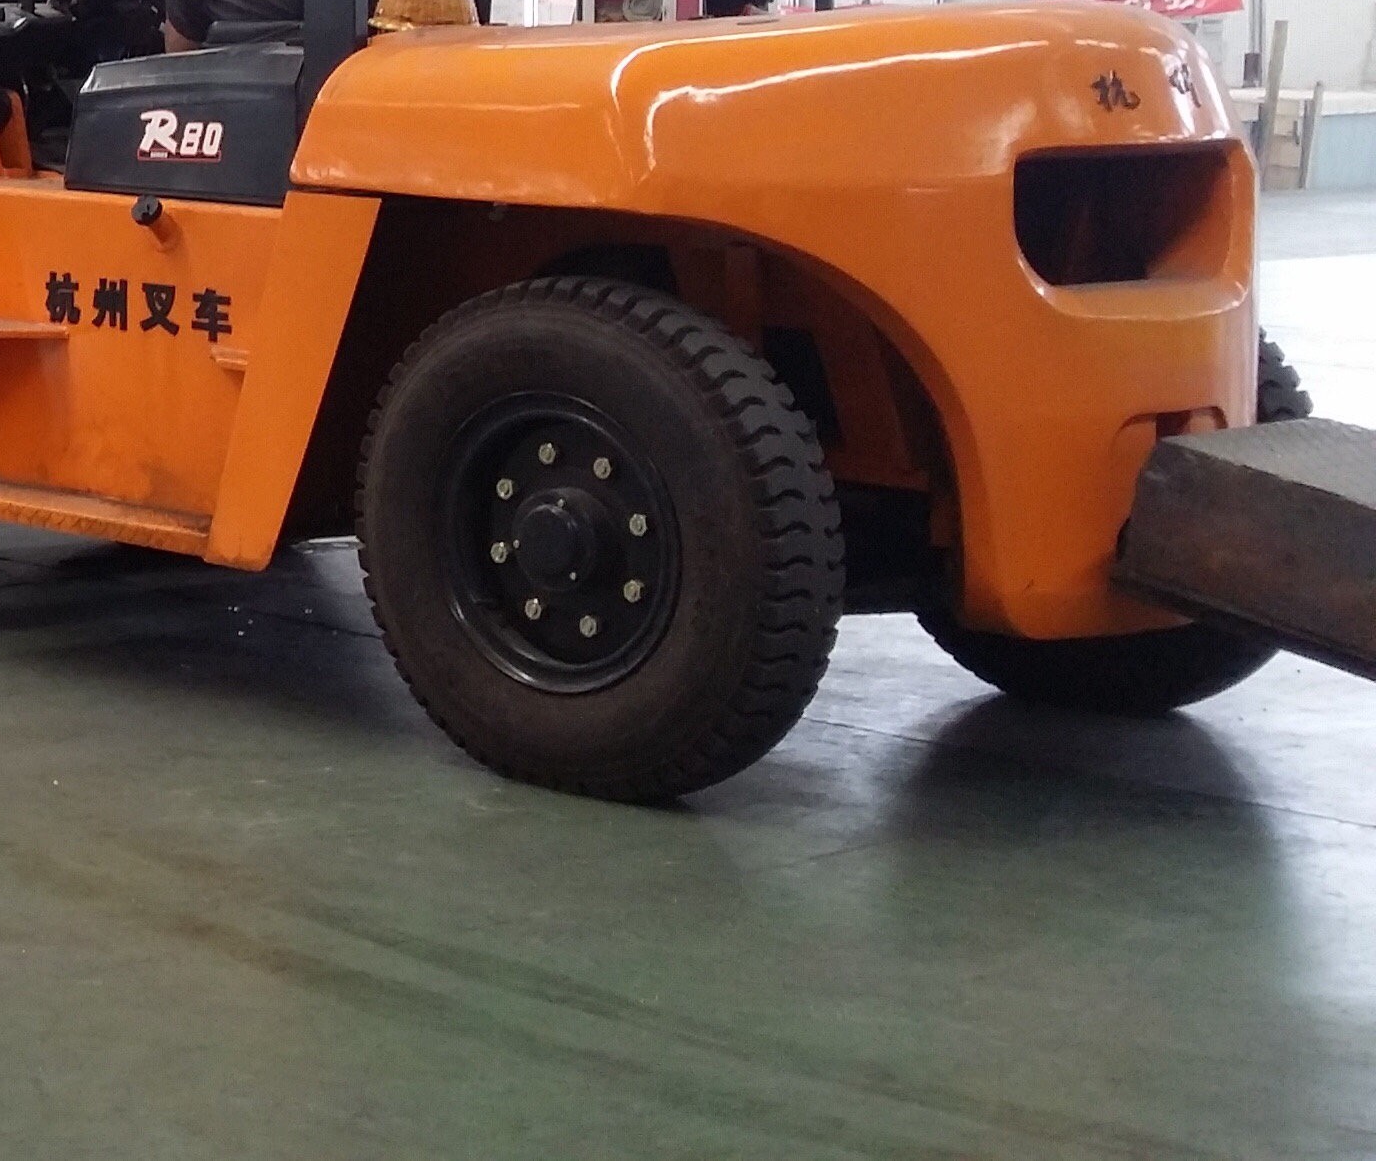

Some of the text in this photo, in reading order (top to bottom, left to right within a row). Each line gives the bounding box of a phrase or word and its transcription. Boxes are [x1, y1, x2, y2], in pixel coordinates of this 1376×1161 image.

[140, 109, 223, 157] R80
[45, 270, 233, 343] 杭州叉车
